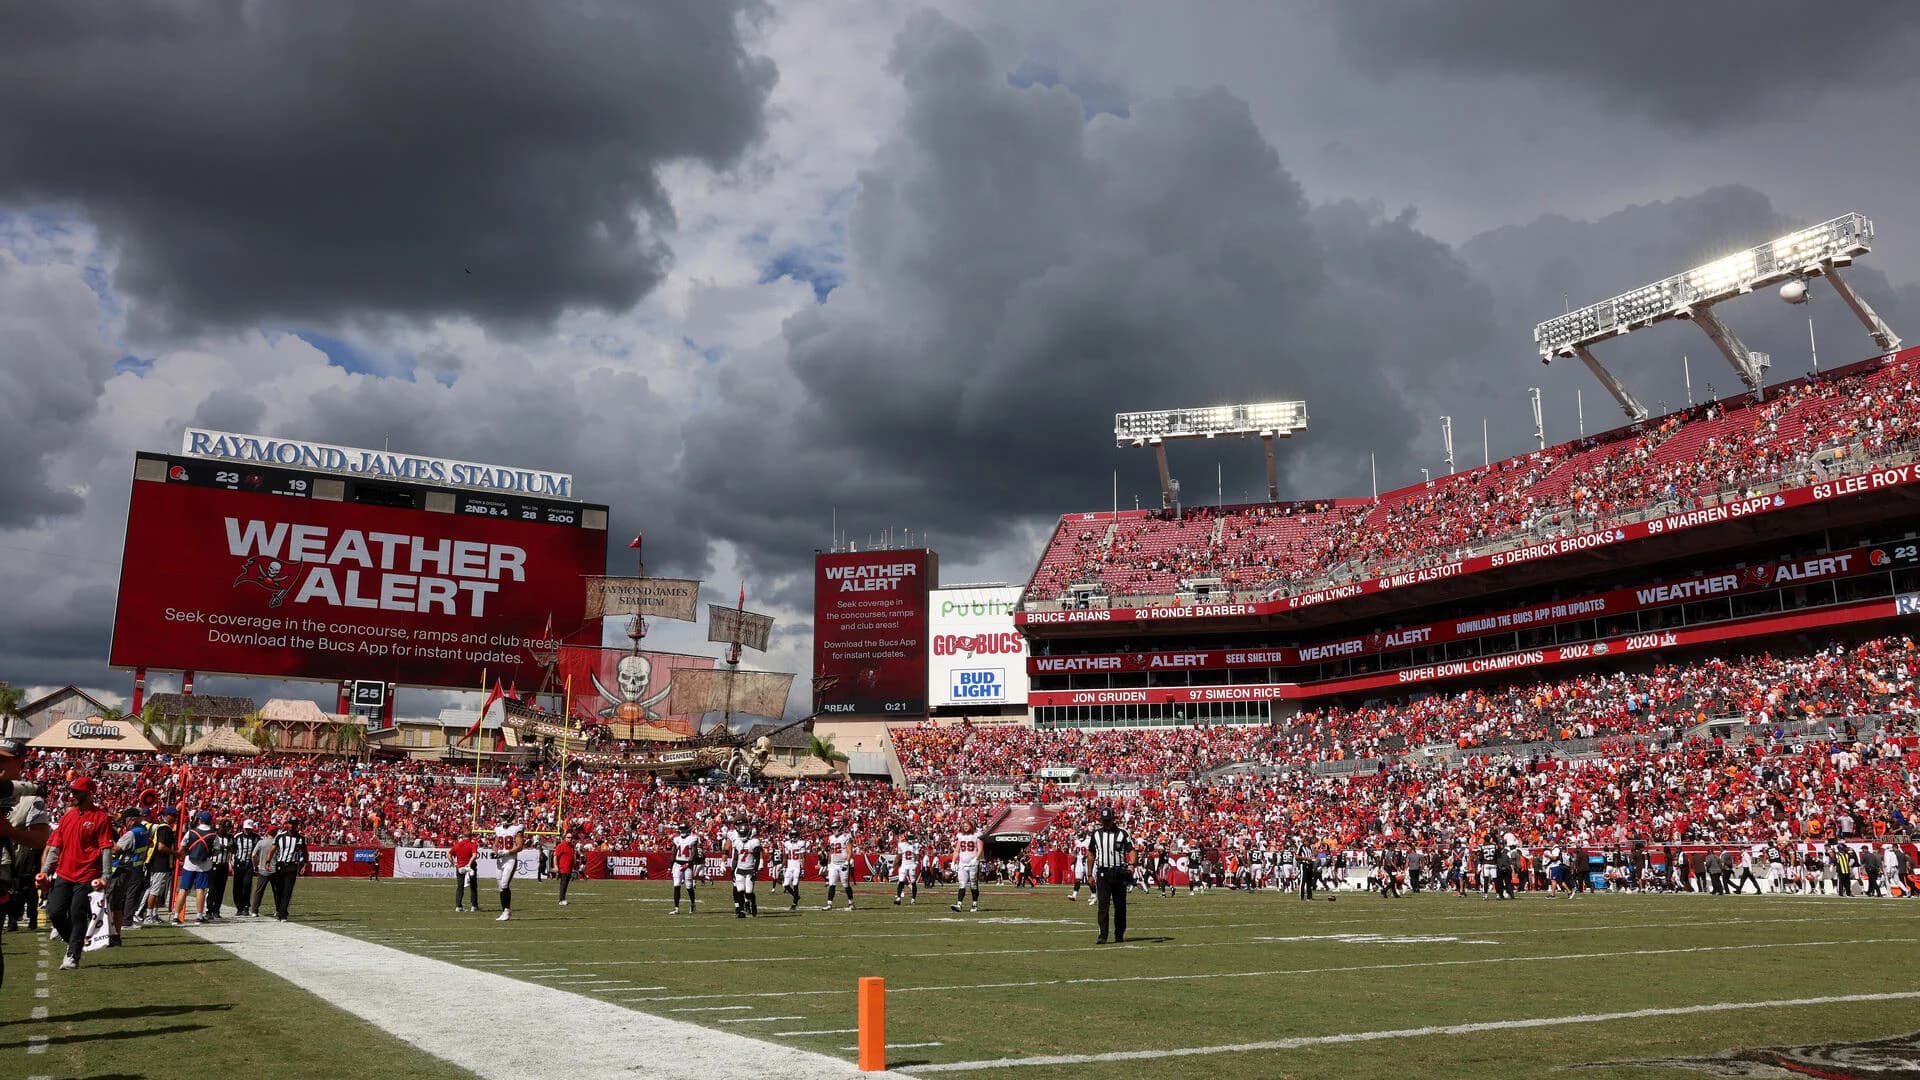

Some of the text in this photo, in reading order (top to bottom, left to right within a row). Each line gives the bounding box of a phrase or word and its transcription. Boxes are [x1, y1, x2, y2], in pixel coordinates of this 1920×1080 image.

[190, 431, 569, 497] RAYMOND JAMES STADIUM
[216, 471, 240, 484] 23
[1813, 484, 1832, 500] 63
[1835, 476, 1870, 496] LEE
[1871, 467, 1909, 489] ROY
[289, 479, 307, 491] 19
[464, 504, 509, 516] 2ND & 4
[521, 511, 537, 520] 28
[1647, 497, 1772, 535] 99 WARREN SAPP
[547, 513, 574, 524] 2:00
[223, 516, 527, 582] WEATHER
[1491, 530, 1614, 567] 55 DERRICK BROOKS
[1894, 545, 1918, 559] 23
[825, 563, 916, 579] WEATHER
[1378, 562, 1464, 589] 40 MIKE ALSTOTT
[840, 577, 901, 592] ALERT
[1636, 554, 1851, 605] WEATHER ALERT
[294, 567, 500, 618] ALERT
[1289, 584, 1356, 608] 47 JOHN LYNCH
[837, 600, 857, 608] Seek
[858, 600, 894, 609] coverage
[1135, 604, 1246, 619] 20 RONDÉ BARBER
[826, 610, 914, 620] the concourses, ramps
[1027, 610, 1111, 624] BRUCE ARIANS
[1456, 598, 1605, 634] DOWNLOAD THE BUCS APP FOR UPDATES
[164, 607, 205, 624] Seek
[208, 613, 282, 631] coverage
[285, 617, 299, 630] in
[302, 618, 327, 632] the
[329, 622, 409, 640] concourse,
[413, 628, 458, 643] ramps
[461, 631, 487, 645] and
[490, 633, 520, 647] club
[840, 621, 899, 630] and club areas!
[208, 629, 524, 665] Download the Bucs App for instant updates.
[824, 638, 916, 649] Download the Bucs App
[933, 632, 1024, 656] GO BUCS
[1299, 628, 1432, 662] WEATHER ALERT
[1626, 633, 1658, 650] 2020
[832, 650, 906, 660] for instant updates.
[1226, 652, 1282, 664] SEEK SHELTER
[1036, 654, 1209, 671] WEATHER ALERT
[1398, 645, 1589, 683] SUPER BOWL CHAMPIONS 2002
[960, 671, 995, 685] BUD
[358, 687, 379, 699] 25
[953, 684, 1002, 698] LIGHT
[1072, 690, 1146, 702] JON GRUDEN
[1190, 687, 1281, 700] 97 SIMEON RICE
[885, 702, 907, 711] 0:21
[68, 720, 120, 740] Corona
[1789, 744, 1805, 754] 19
[107, 763, 135, 771] 1976
[308, 851, 348, 862] RISTAN'S
[405, 850, 448, 860] GLAZER
[740, 849, 750, 862] 7
[310, 862, 339, 873] TROOP
